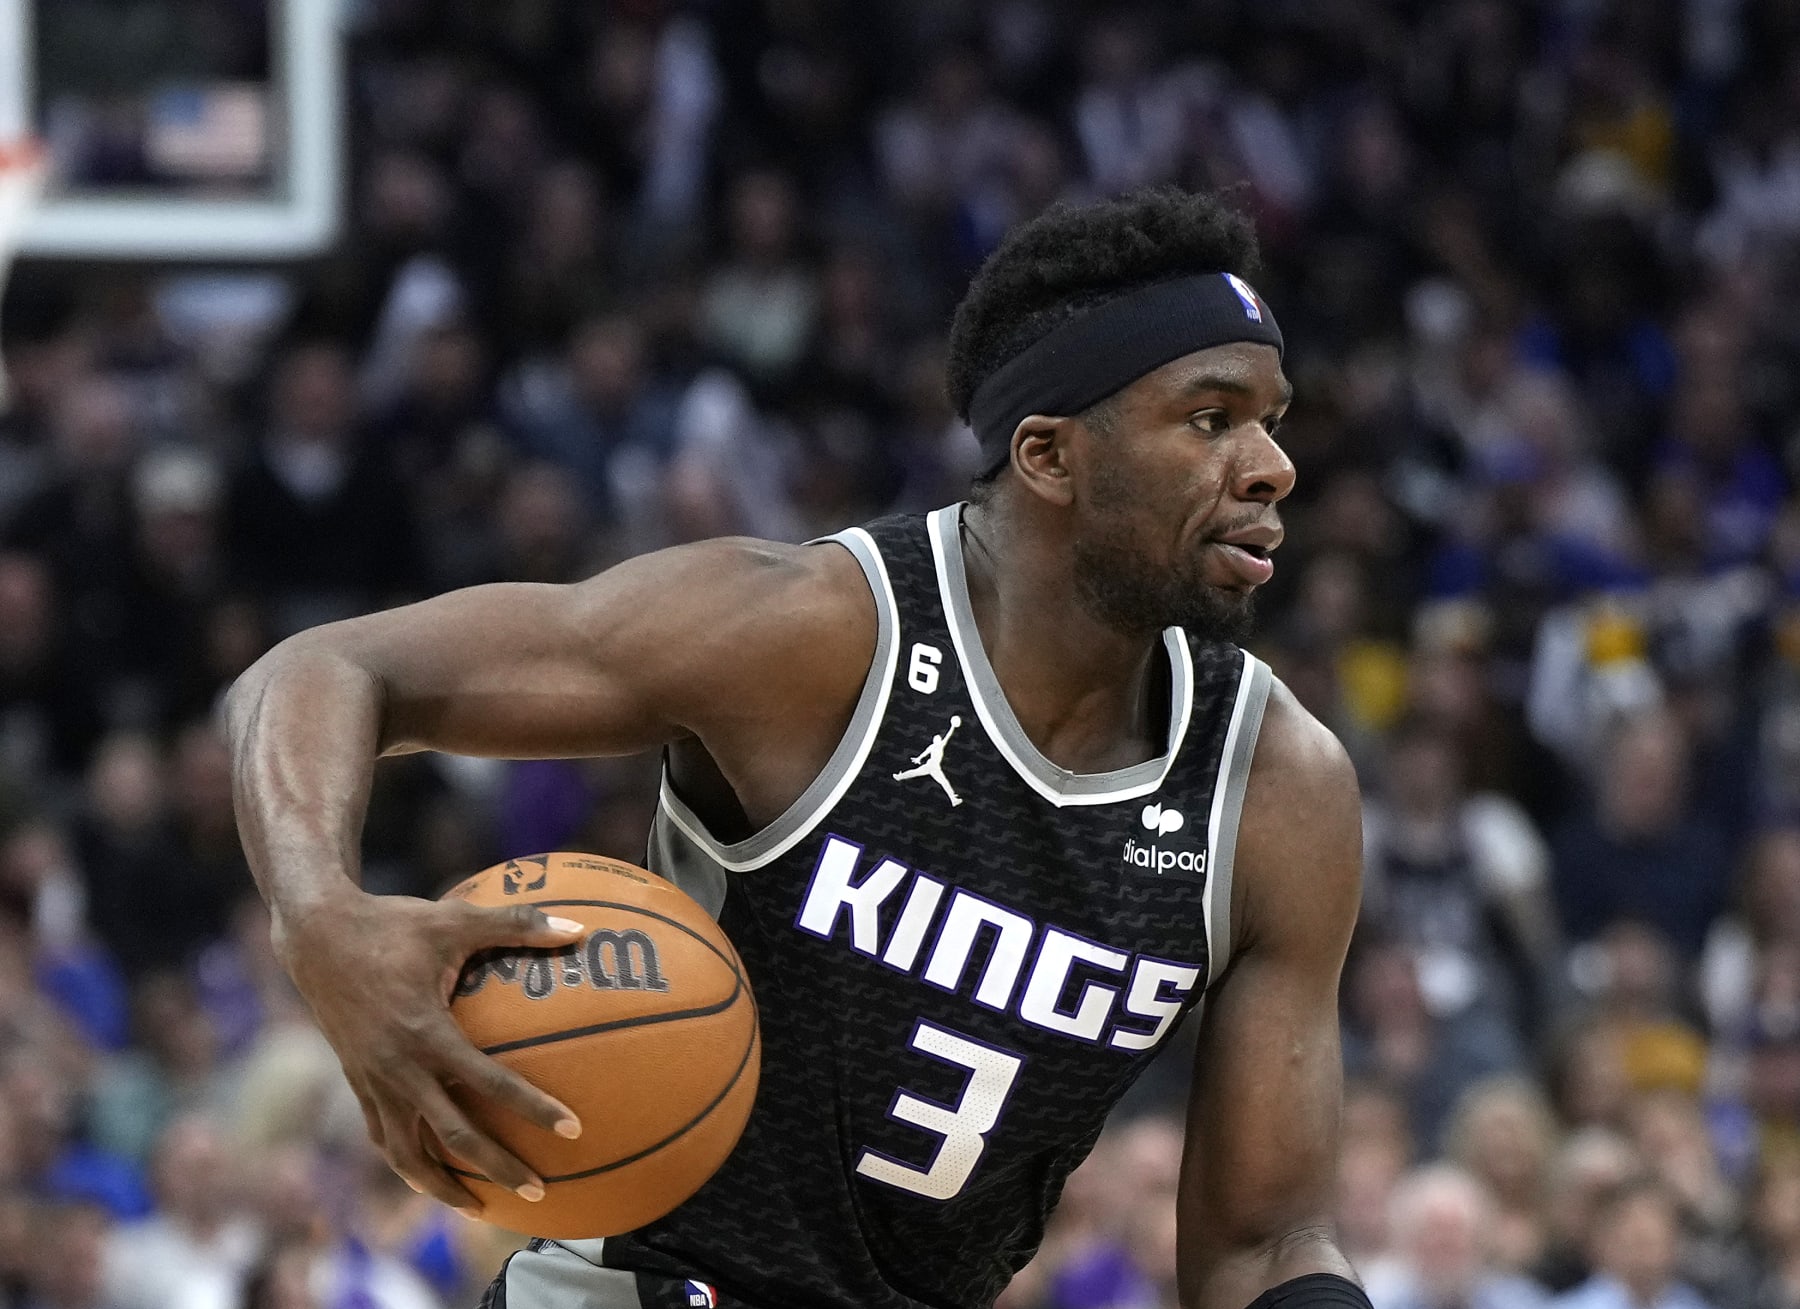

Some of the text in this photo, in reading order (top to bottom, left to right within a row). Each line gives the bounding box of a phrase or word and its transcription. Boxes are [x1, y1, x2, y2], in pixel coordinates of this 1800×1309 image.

[908, 643, 942, 695] 6
[1123, 838, 1206, 875] dialpad
[795, 833, 1201, 1051] KINGS
[854, 1018, 1026, 1201] 3
[689, 1293, 706, 1307] NBA
